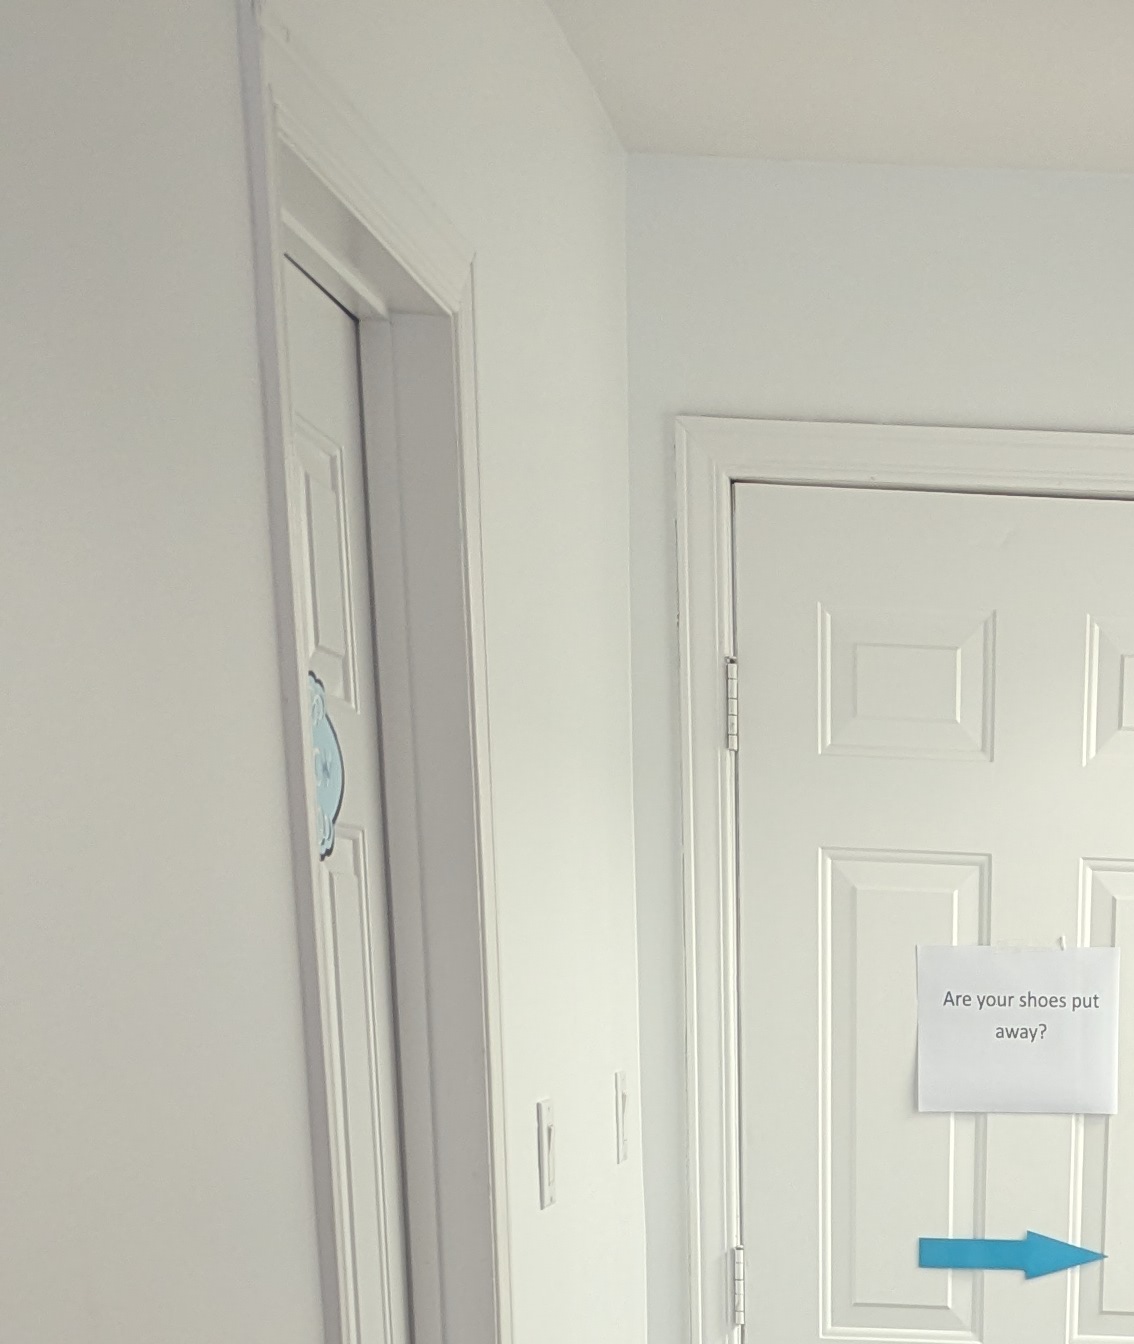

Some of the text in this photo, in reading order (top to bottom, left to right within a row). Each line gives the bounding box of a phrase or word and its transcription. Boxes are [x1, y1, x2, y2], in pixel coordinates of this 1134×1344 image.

[942, 990, 1100, 1012] Are your shoes put
[994, 1023, 1048, 1043] away?
